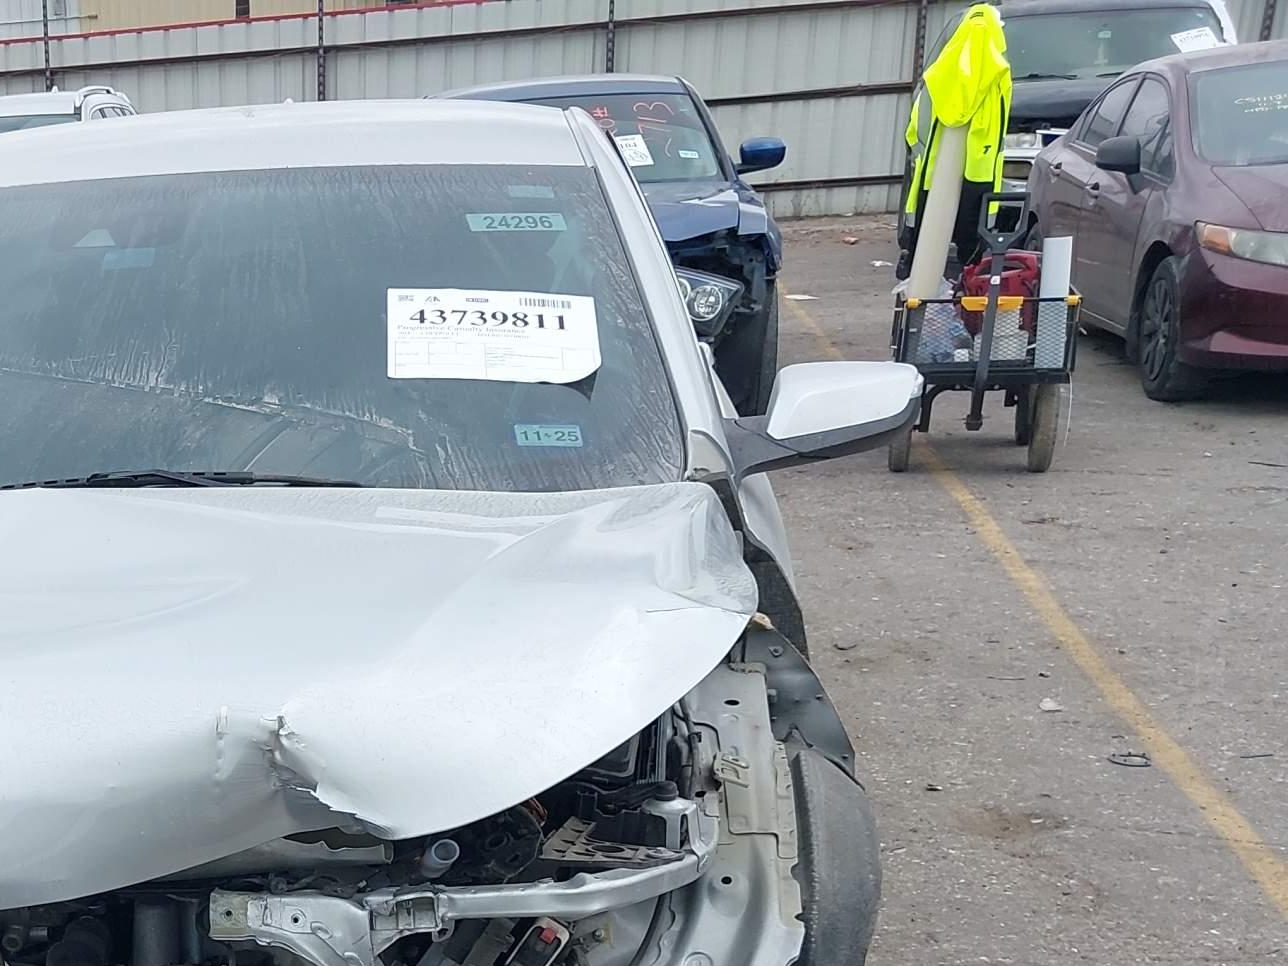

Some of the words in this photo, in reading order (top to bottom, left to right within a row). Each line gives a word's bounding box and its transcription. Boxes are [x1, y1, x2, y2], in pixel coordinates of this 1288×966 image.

[483, 215, 553, 229] 24296
[409, 309, 568, 331] 43739811
[520, 430, 579, 442] 11-25
